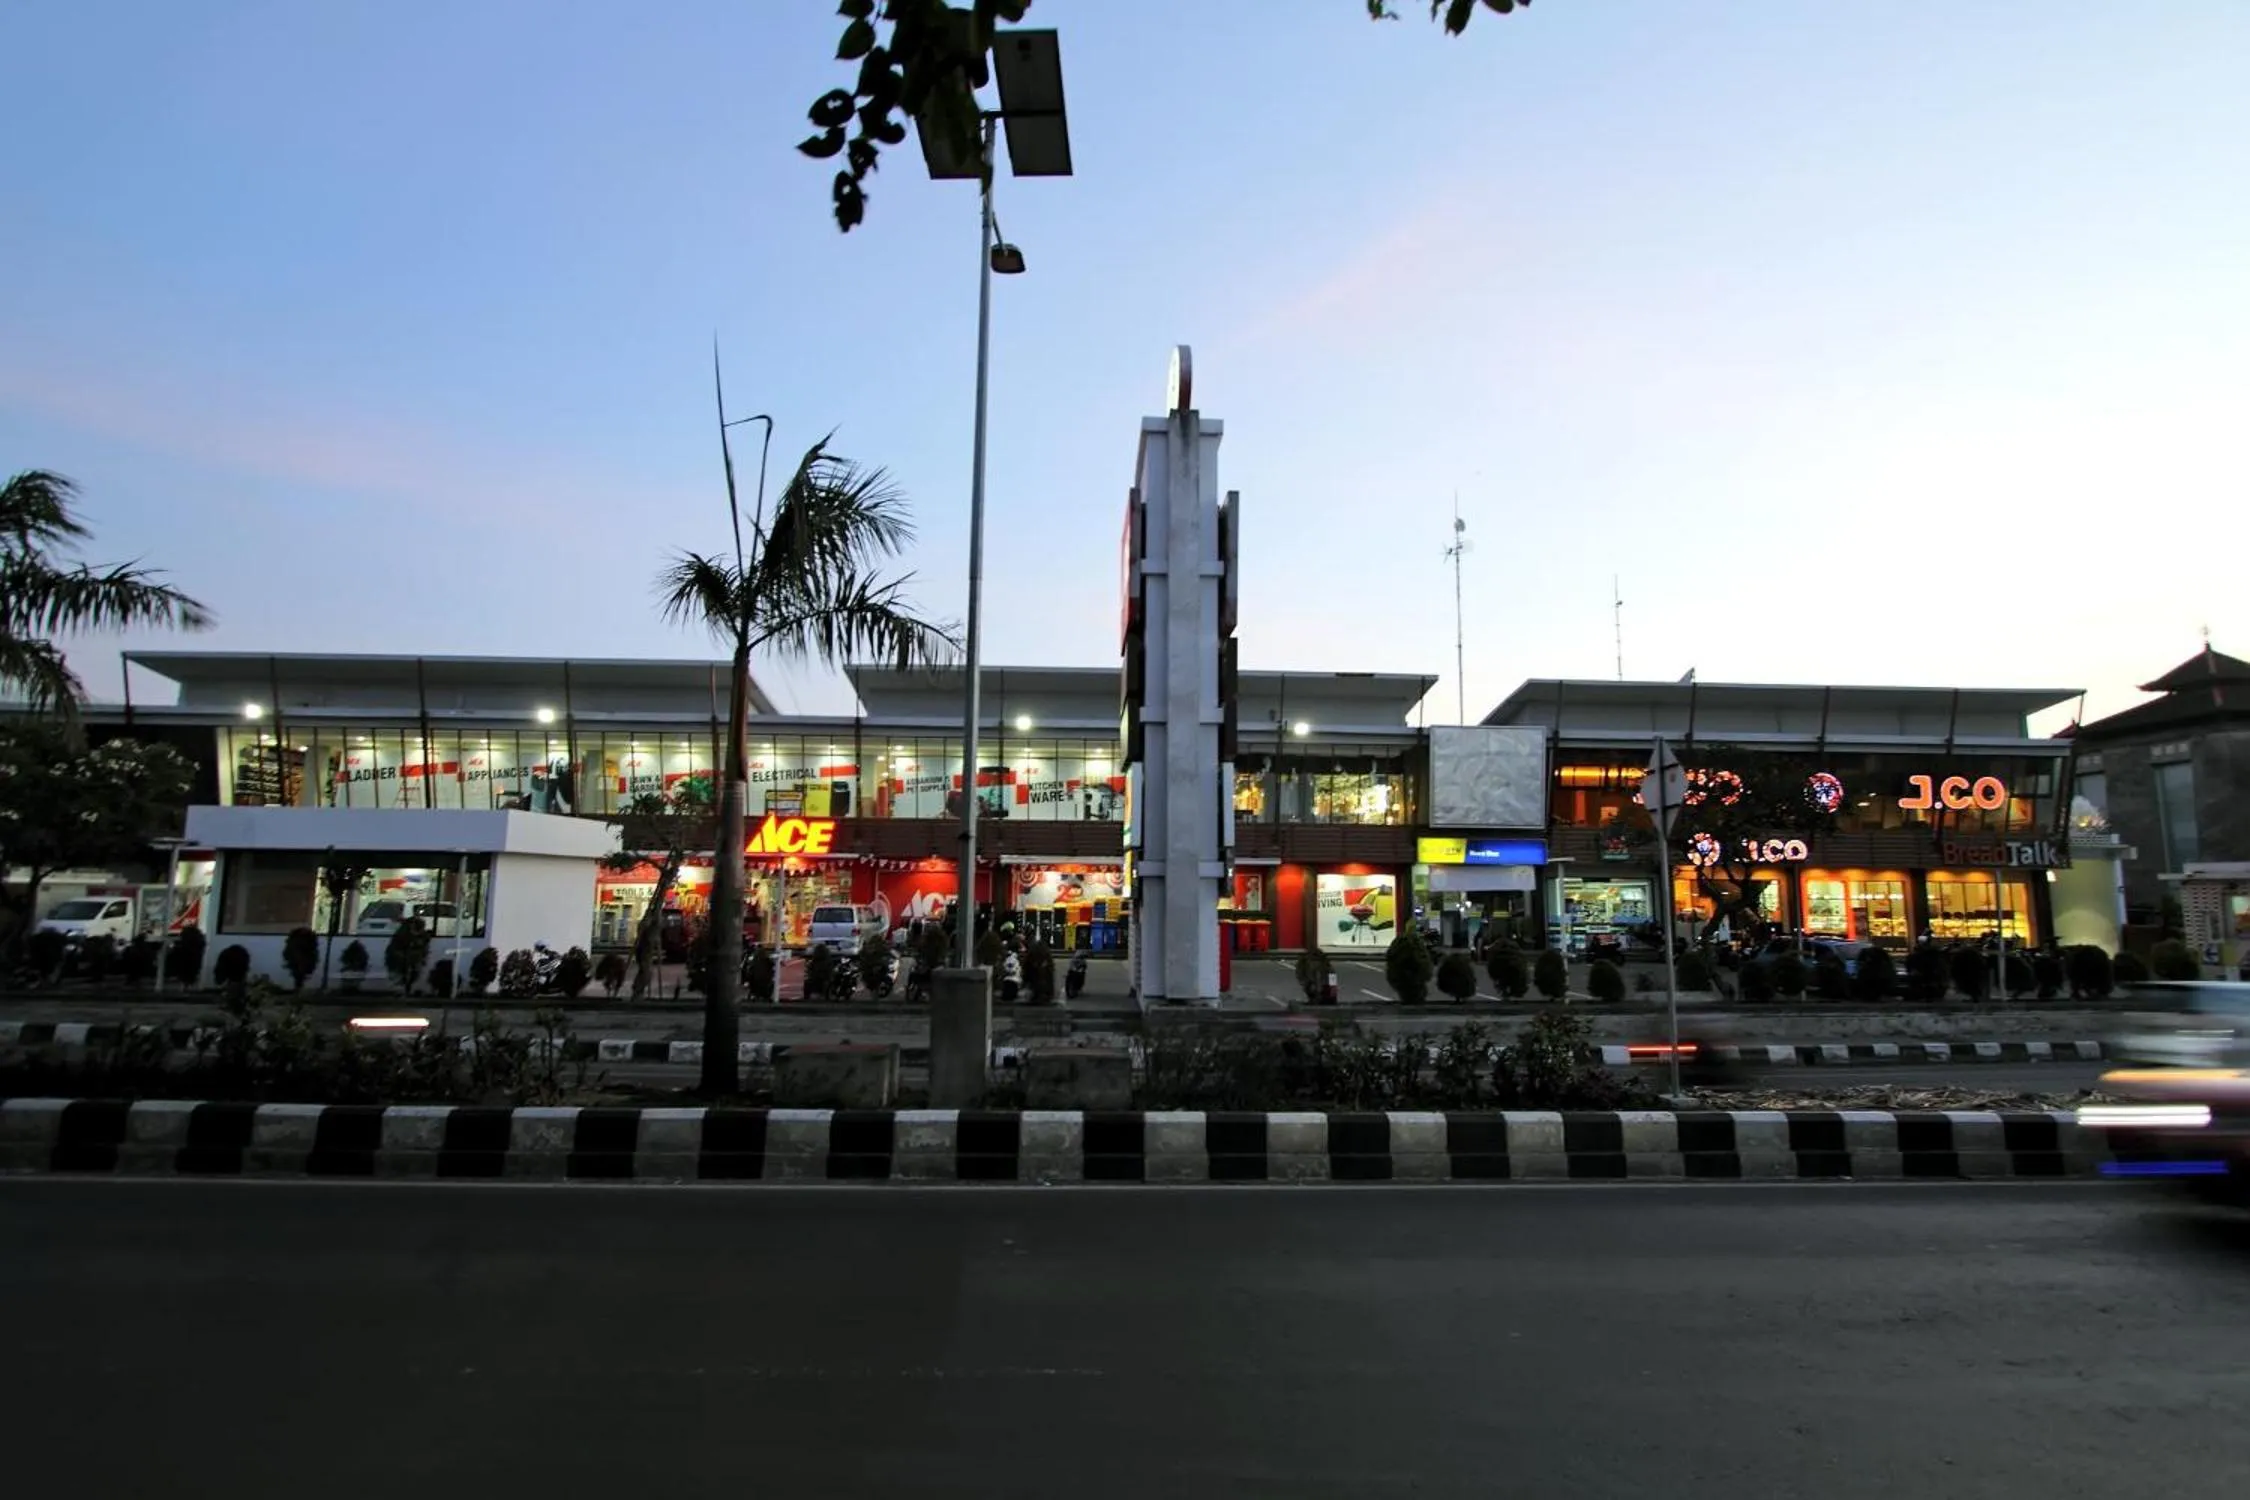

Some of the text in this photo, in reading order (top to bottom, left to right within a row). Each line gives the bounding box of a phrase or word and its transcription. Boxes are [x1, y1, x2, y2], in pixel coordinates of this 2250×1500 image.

[346, 766, 396, 782] LADDER
[752, 768, 817, 782] ELECTRICAL
[1031, 790, 1065, 804] WARE
[1898, 774, 2006, 810] J.CO
[745, 812, 835, 853] ACE
